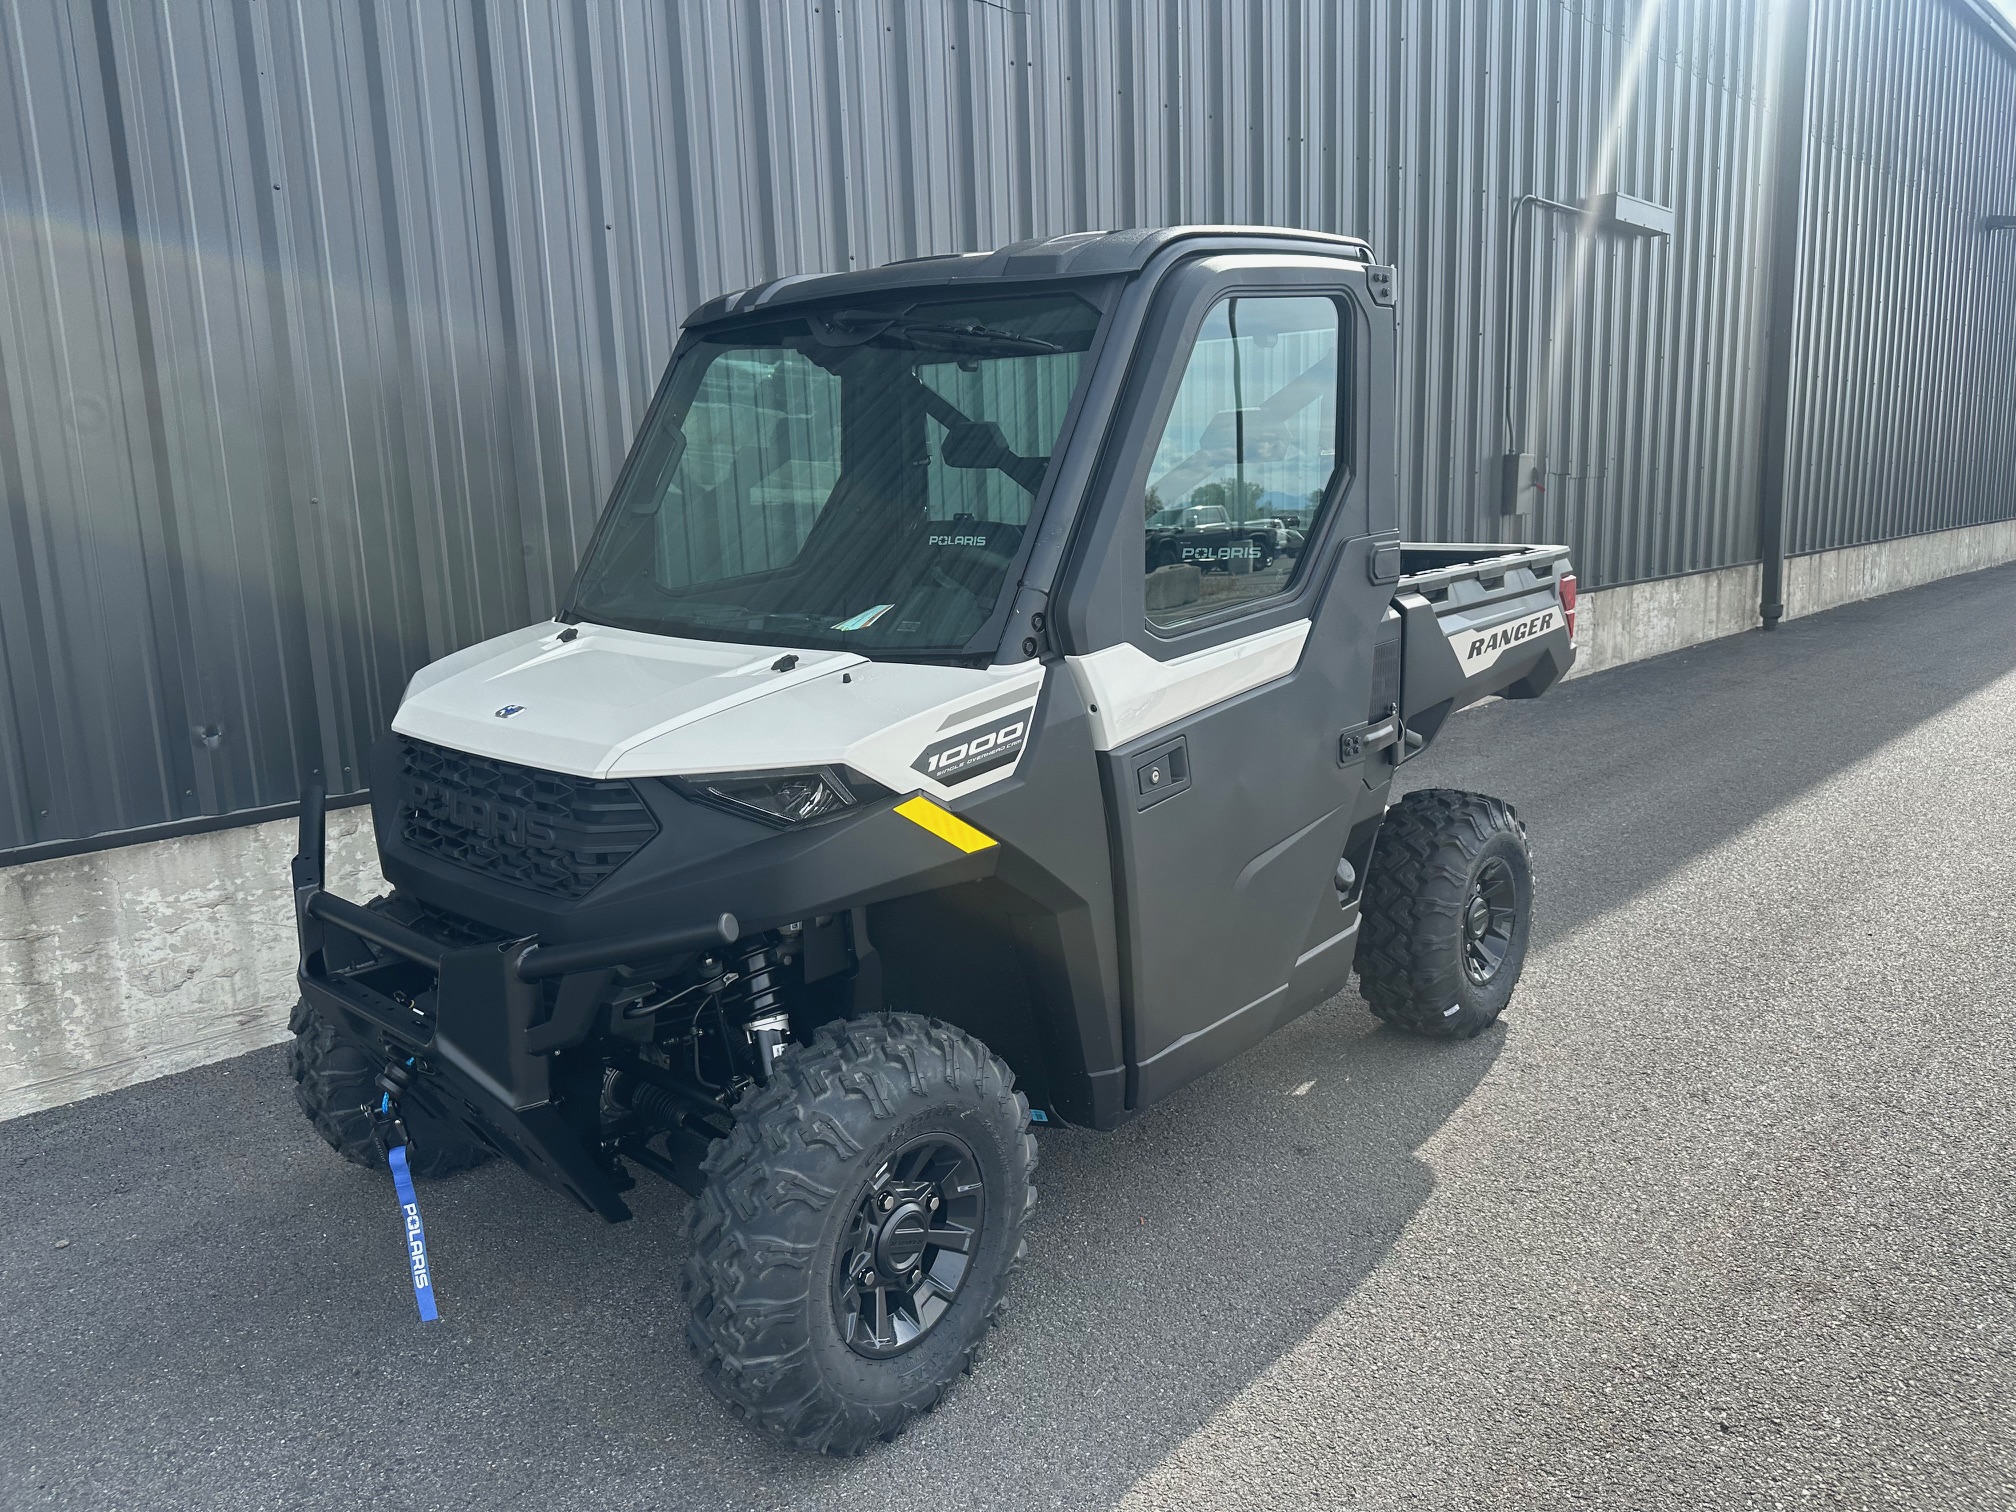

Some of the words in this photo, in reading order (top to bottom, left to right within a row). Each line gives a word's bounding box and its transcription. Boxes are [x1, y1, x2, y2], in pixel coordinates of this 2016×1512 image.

[928, 535, 986, 546] POLARIS
[1182, 547, 1262, 559] POLARIS
[1467, 612, 1553, 660] RANGER
[927, 721, 1024, 773] 1000
[936, 762, 965, 777] SINGLE
[966, 745, 1006, 764] OVERHEAD
[1006, 739, 1022, 749] CAM
[407, 779, 556, 850] POLARIS
[403, 1203, 429, 1289] POLARIS
